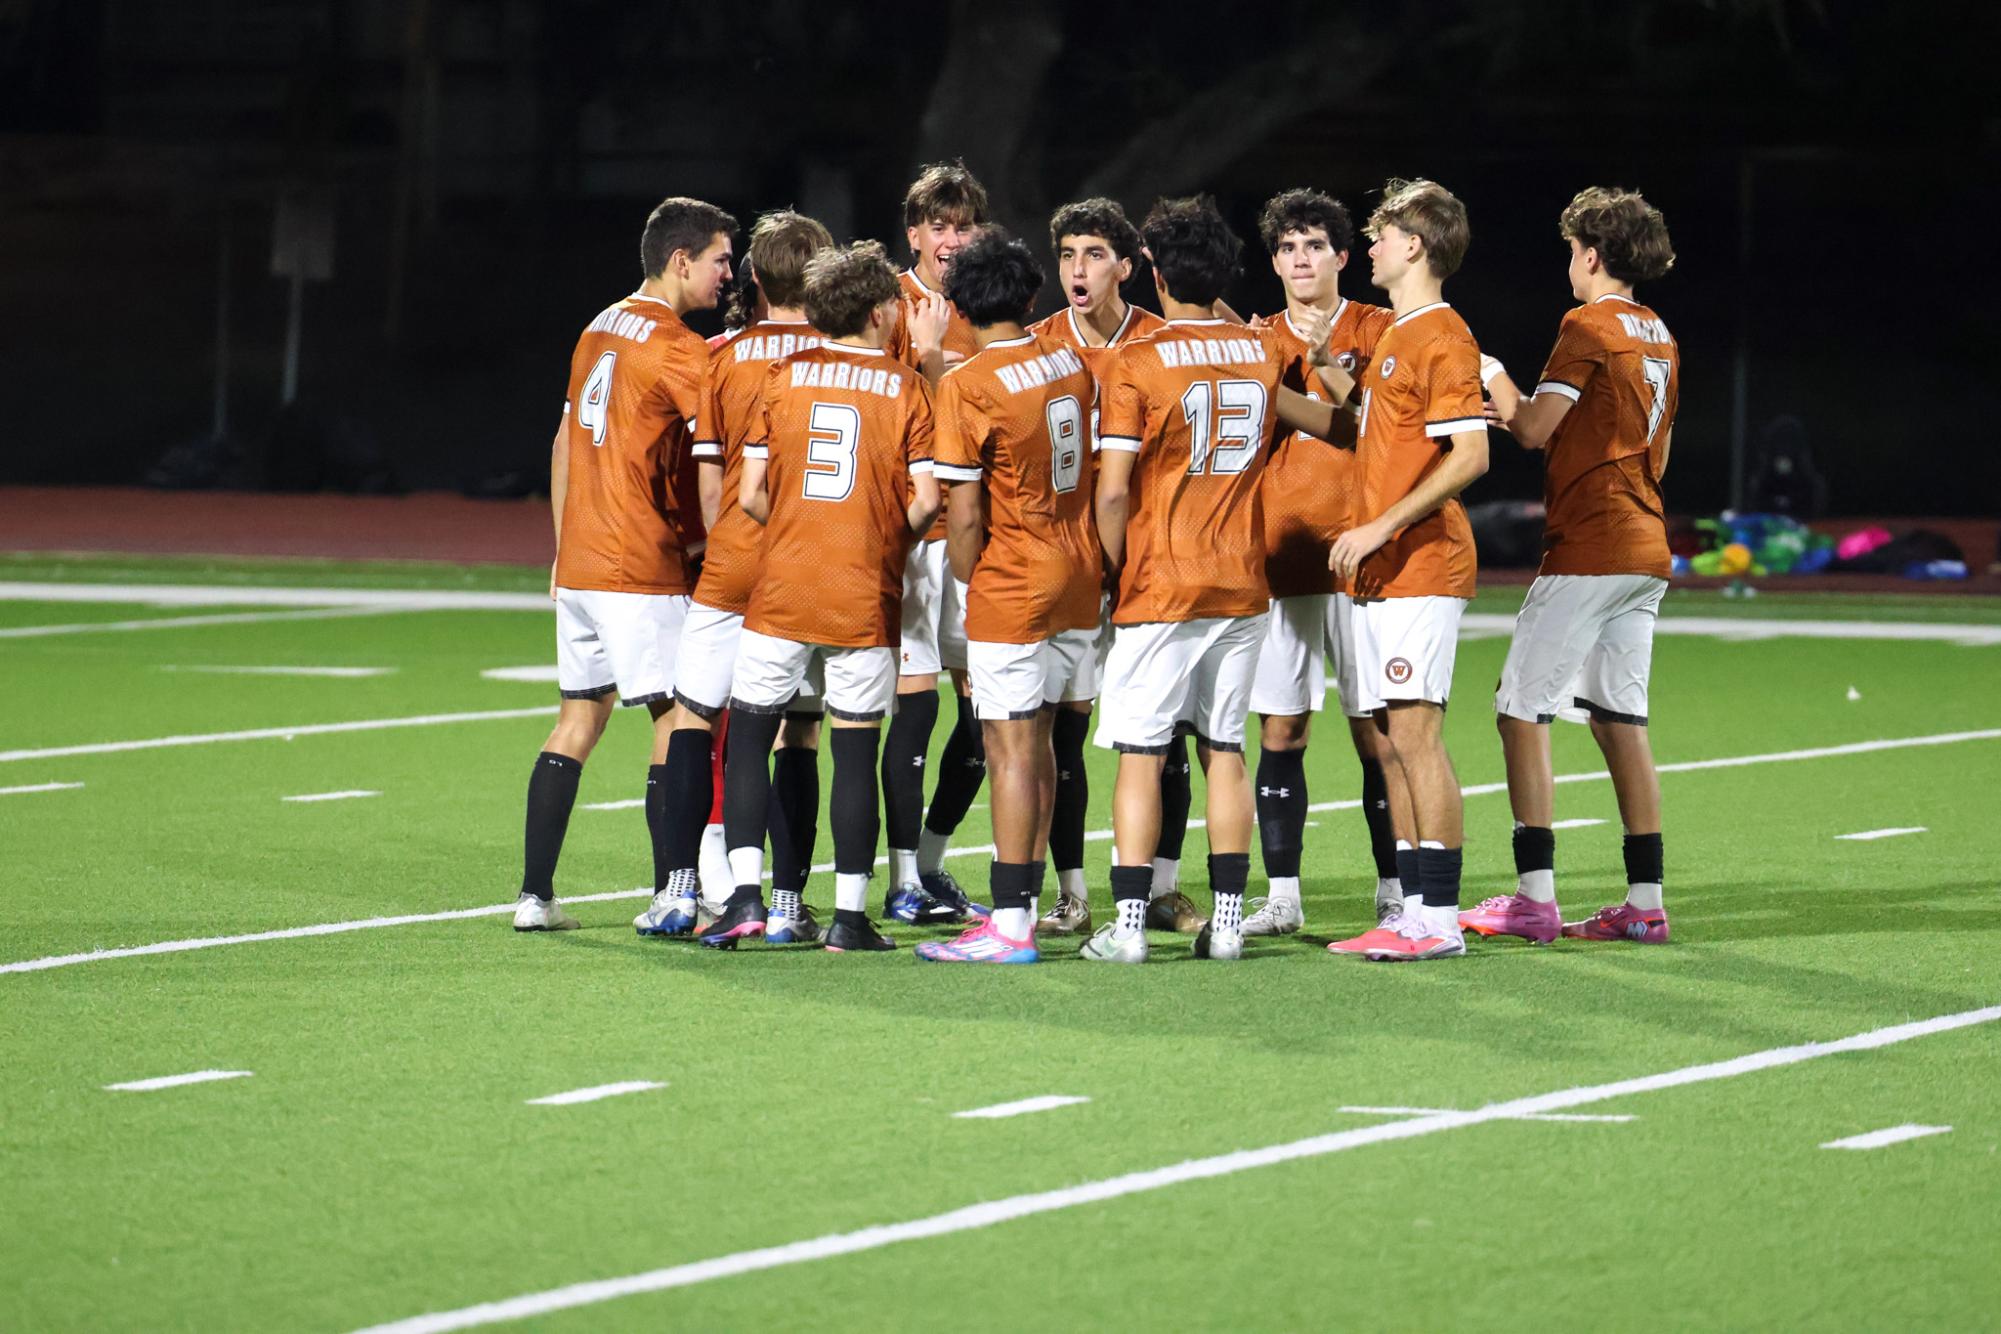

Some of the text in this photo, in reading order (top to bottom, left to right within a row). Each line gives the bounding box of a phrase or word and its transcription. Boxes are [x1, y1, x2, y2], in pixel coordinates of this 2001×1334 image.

[734, 333, 824, 363] WARRIO
[790, 361, 902, 399] WARRIORS
[1154, 338, 1266, 368] WARRIORS
[578, 350, 617, 447] 4
[1046, 394, 1083, 494] 8
[1180, 379, 1267, 475] 13
[1642, 355, 1671, 446] 7
[802, 401, 860, 502] 3
